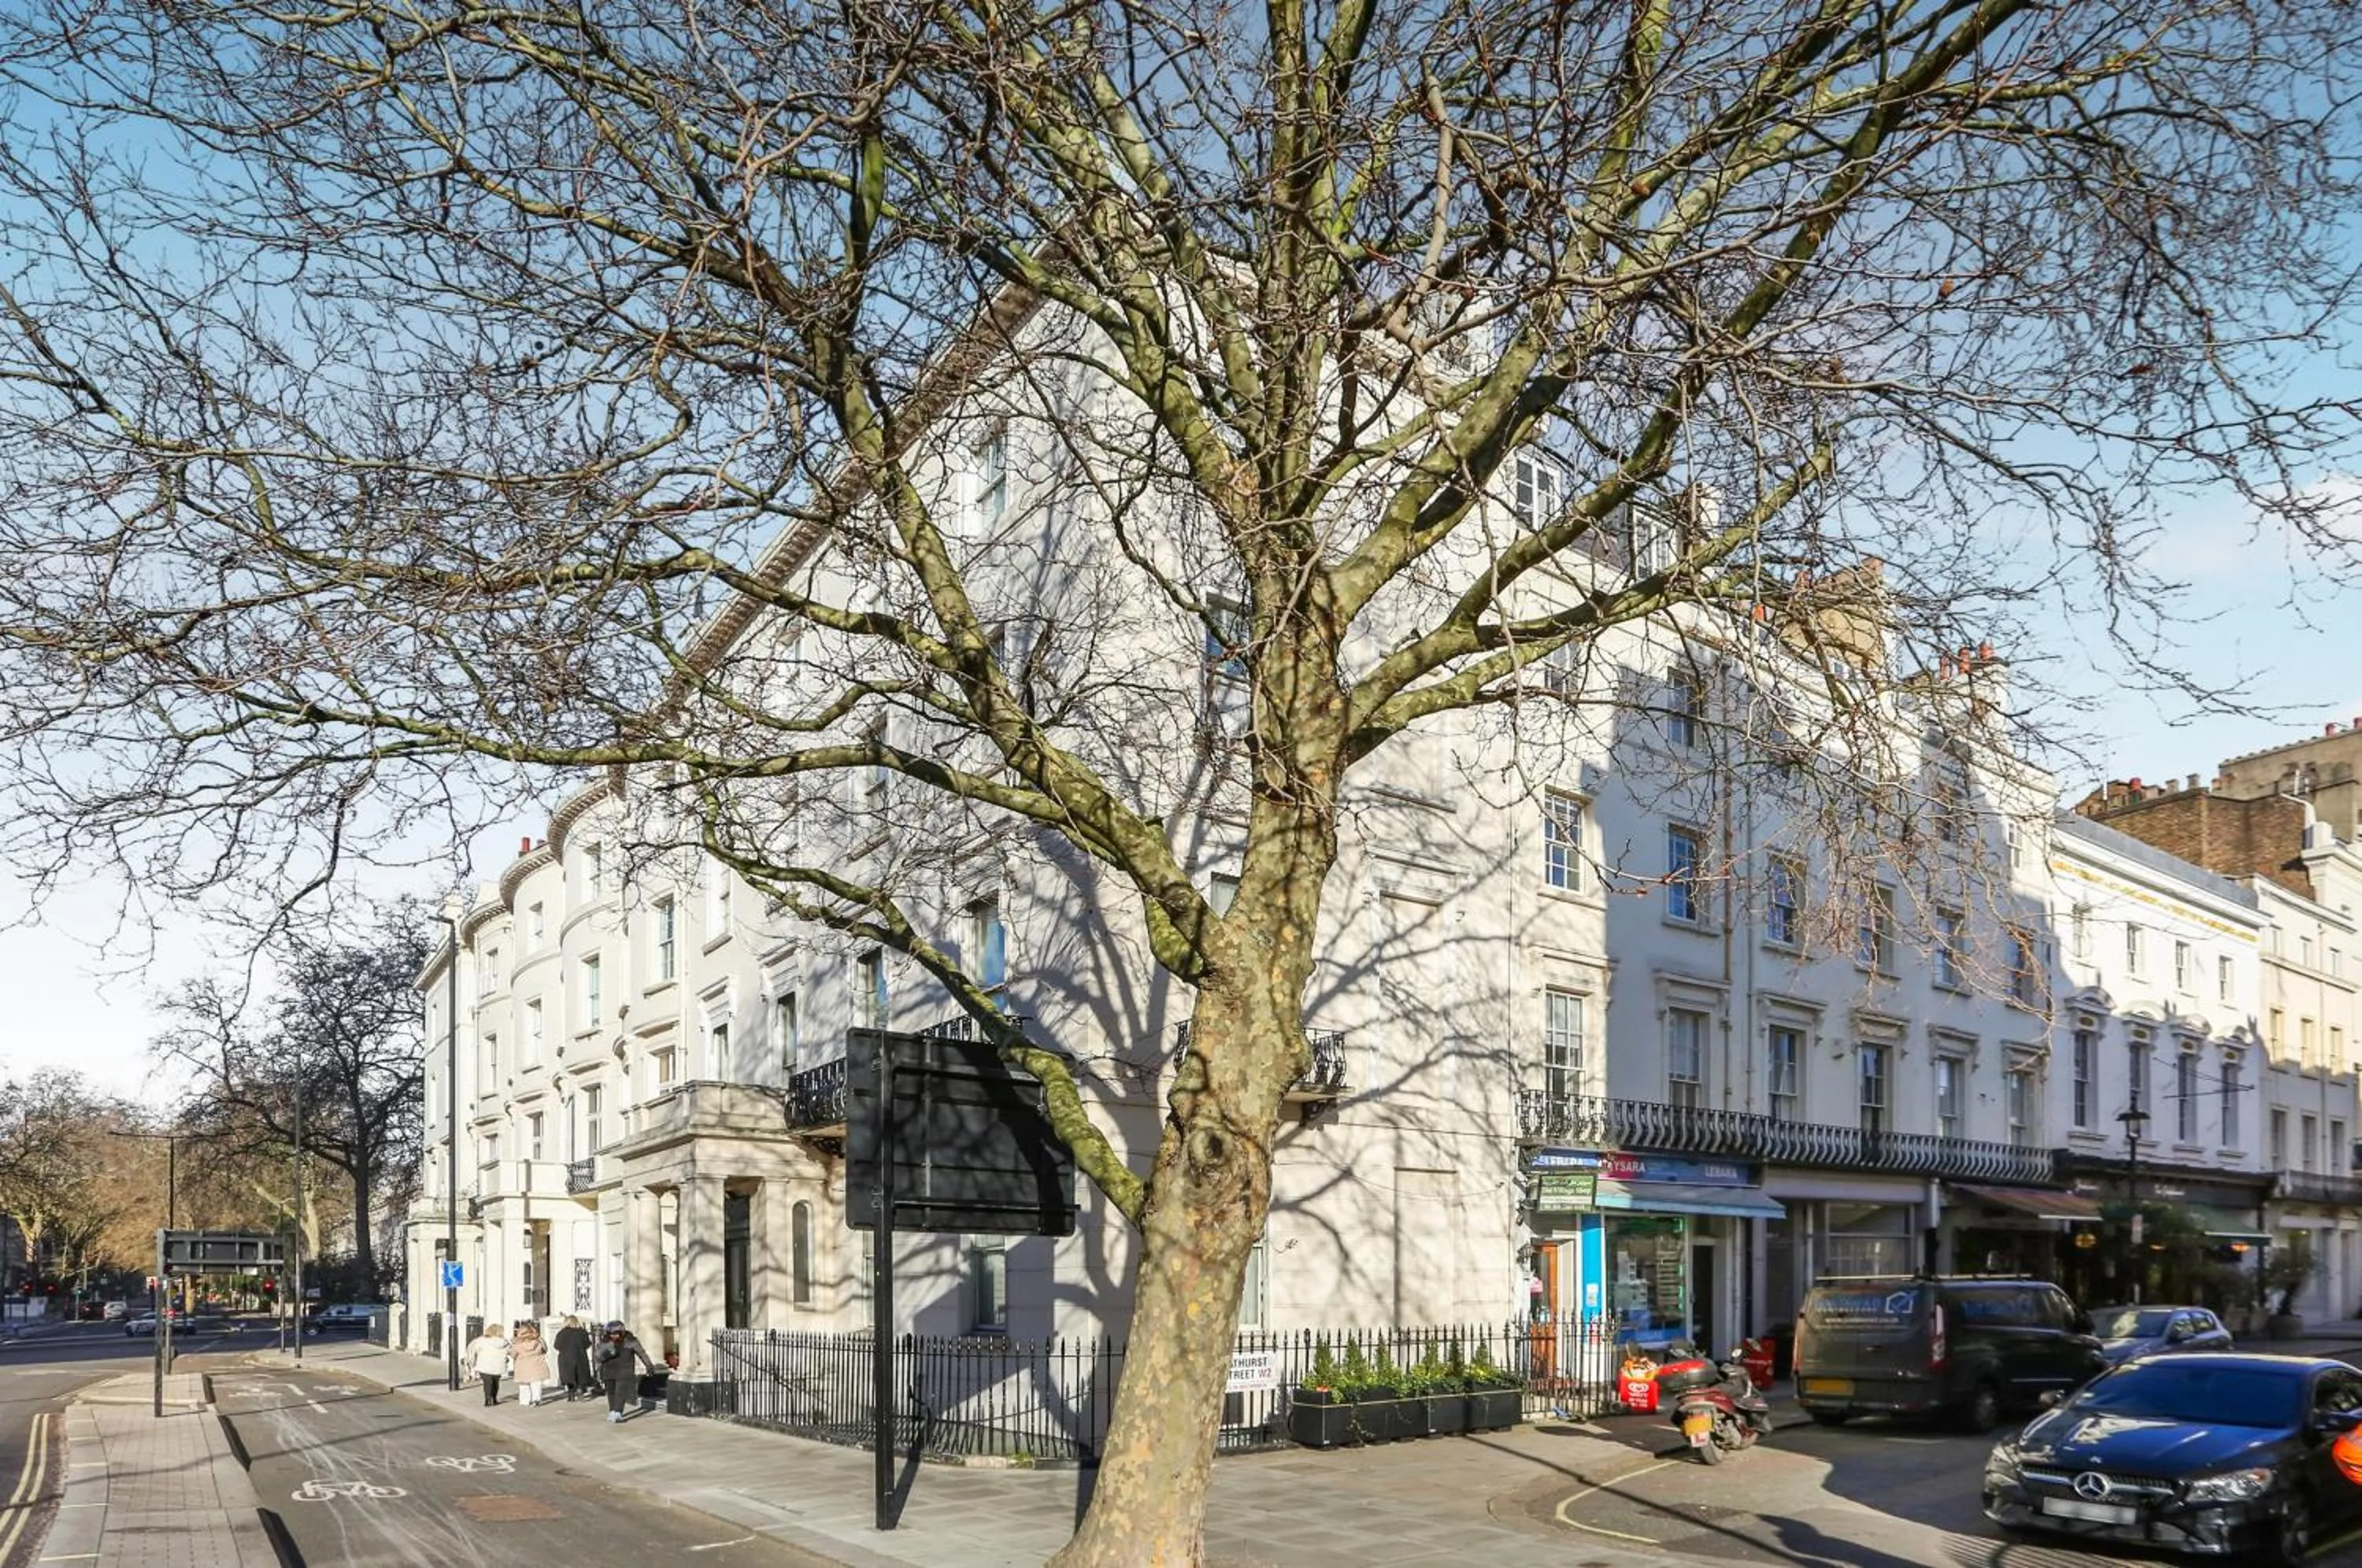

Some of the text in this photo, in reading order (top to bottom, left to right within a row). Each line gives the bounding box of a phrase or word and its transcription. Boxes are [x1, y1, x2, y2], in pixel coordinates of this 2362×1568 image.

[1231, 1357, 1268, 1368] THURST
[1228, 1367, 1272, 1380] TREET W2
